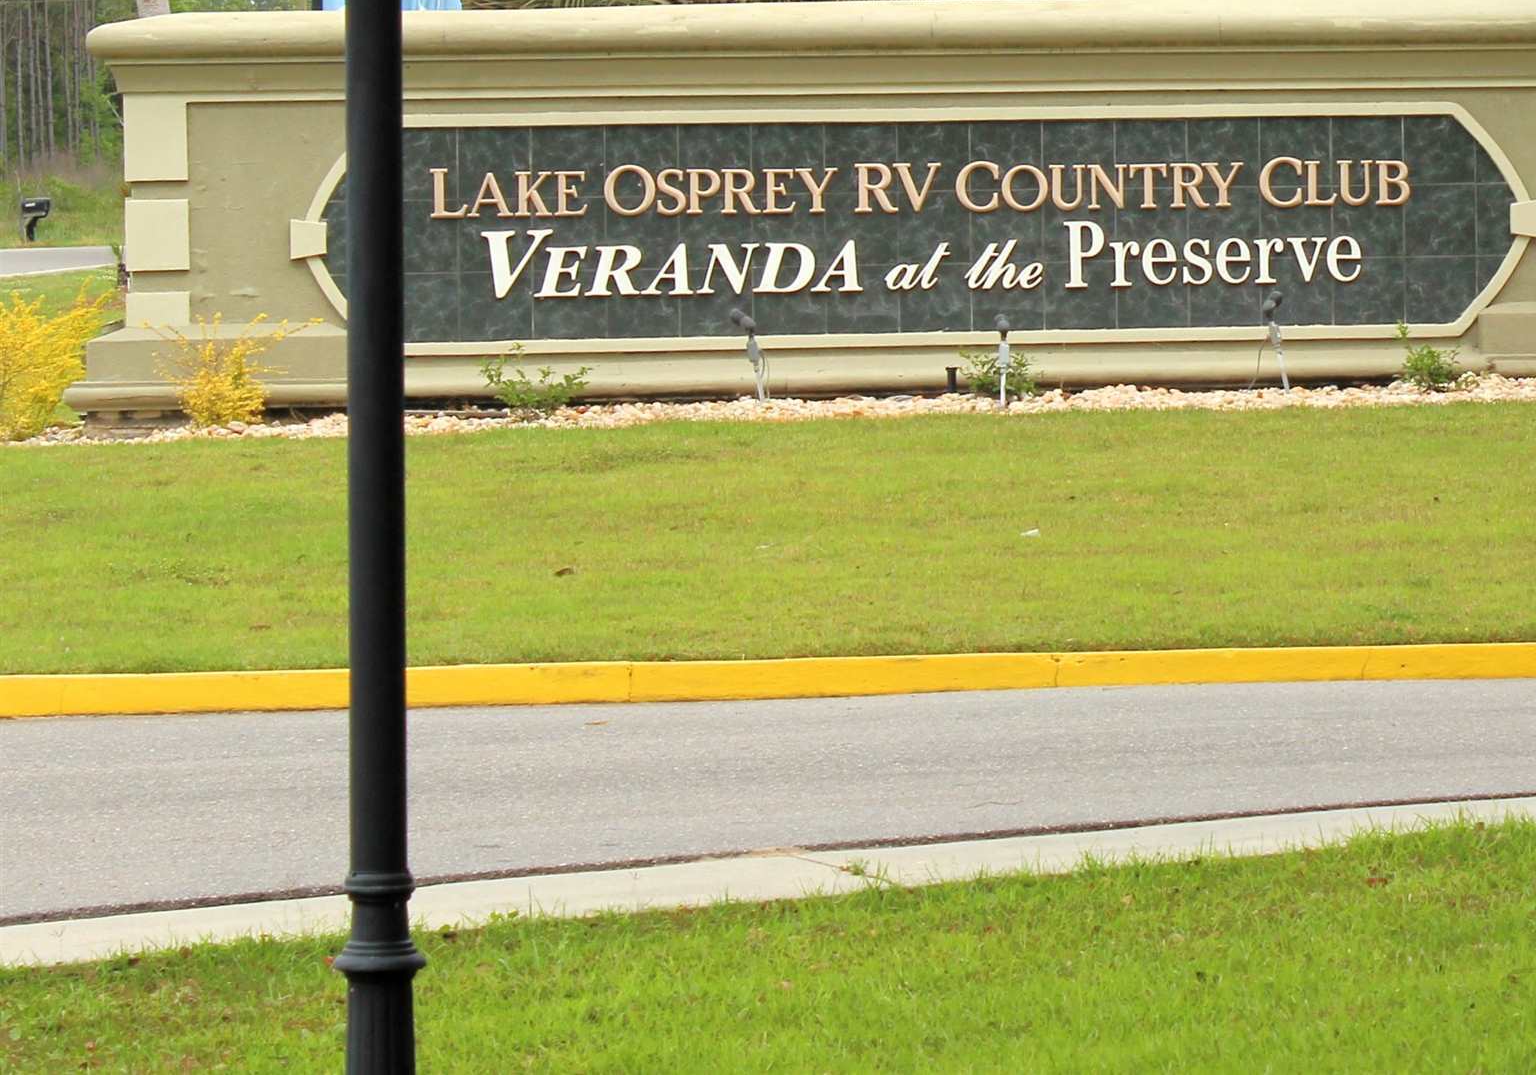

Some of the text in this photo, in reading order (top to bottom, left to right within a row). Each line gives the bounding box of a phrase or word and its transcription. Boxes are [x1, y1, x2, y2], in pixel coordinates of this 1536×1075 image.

[429, 156, 1412, 219] LAKE OSPREY RV COUNTRY CLUB
[480, 220, 1363, 299] VERANDA at the Preserve
